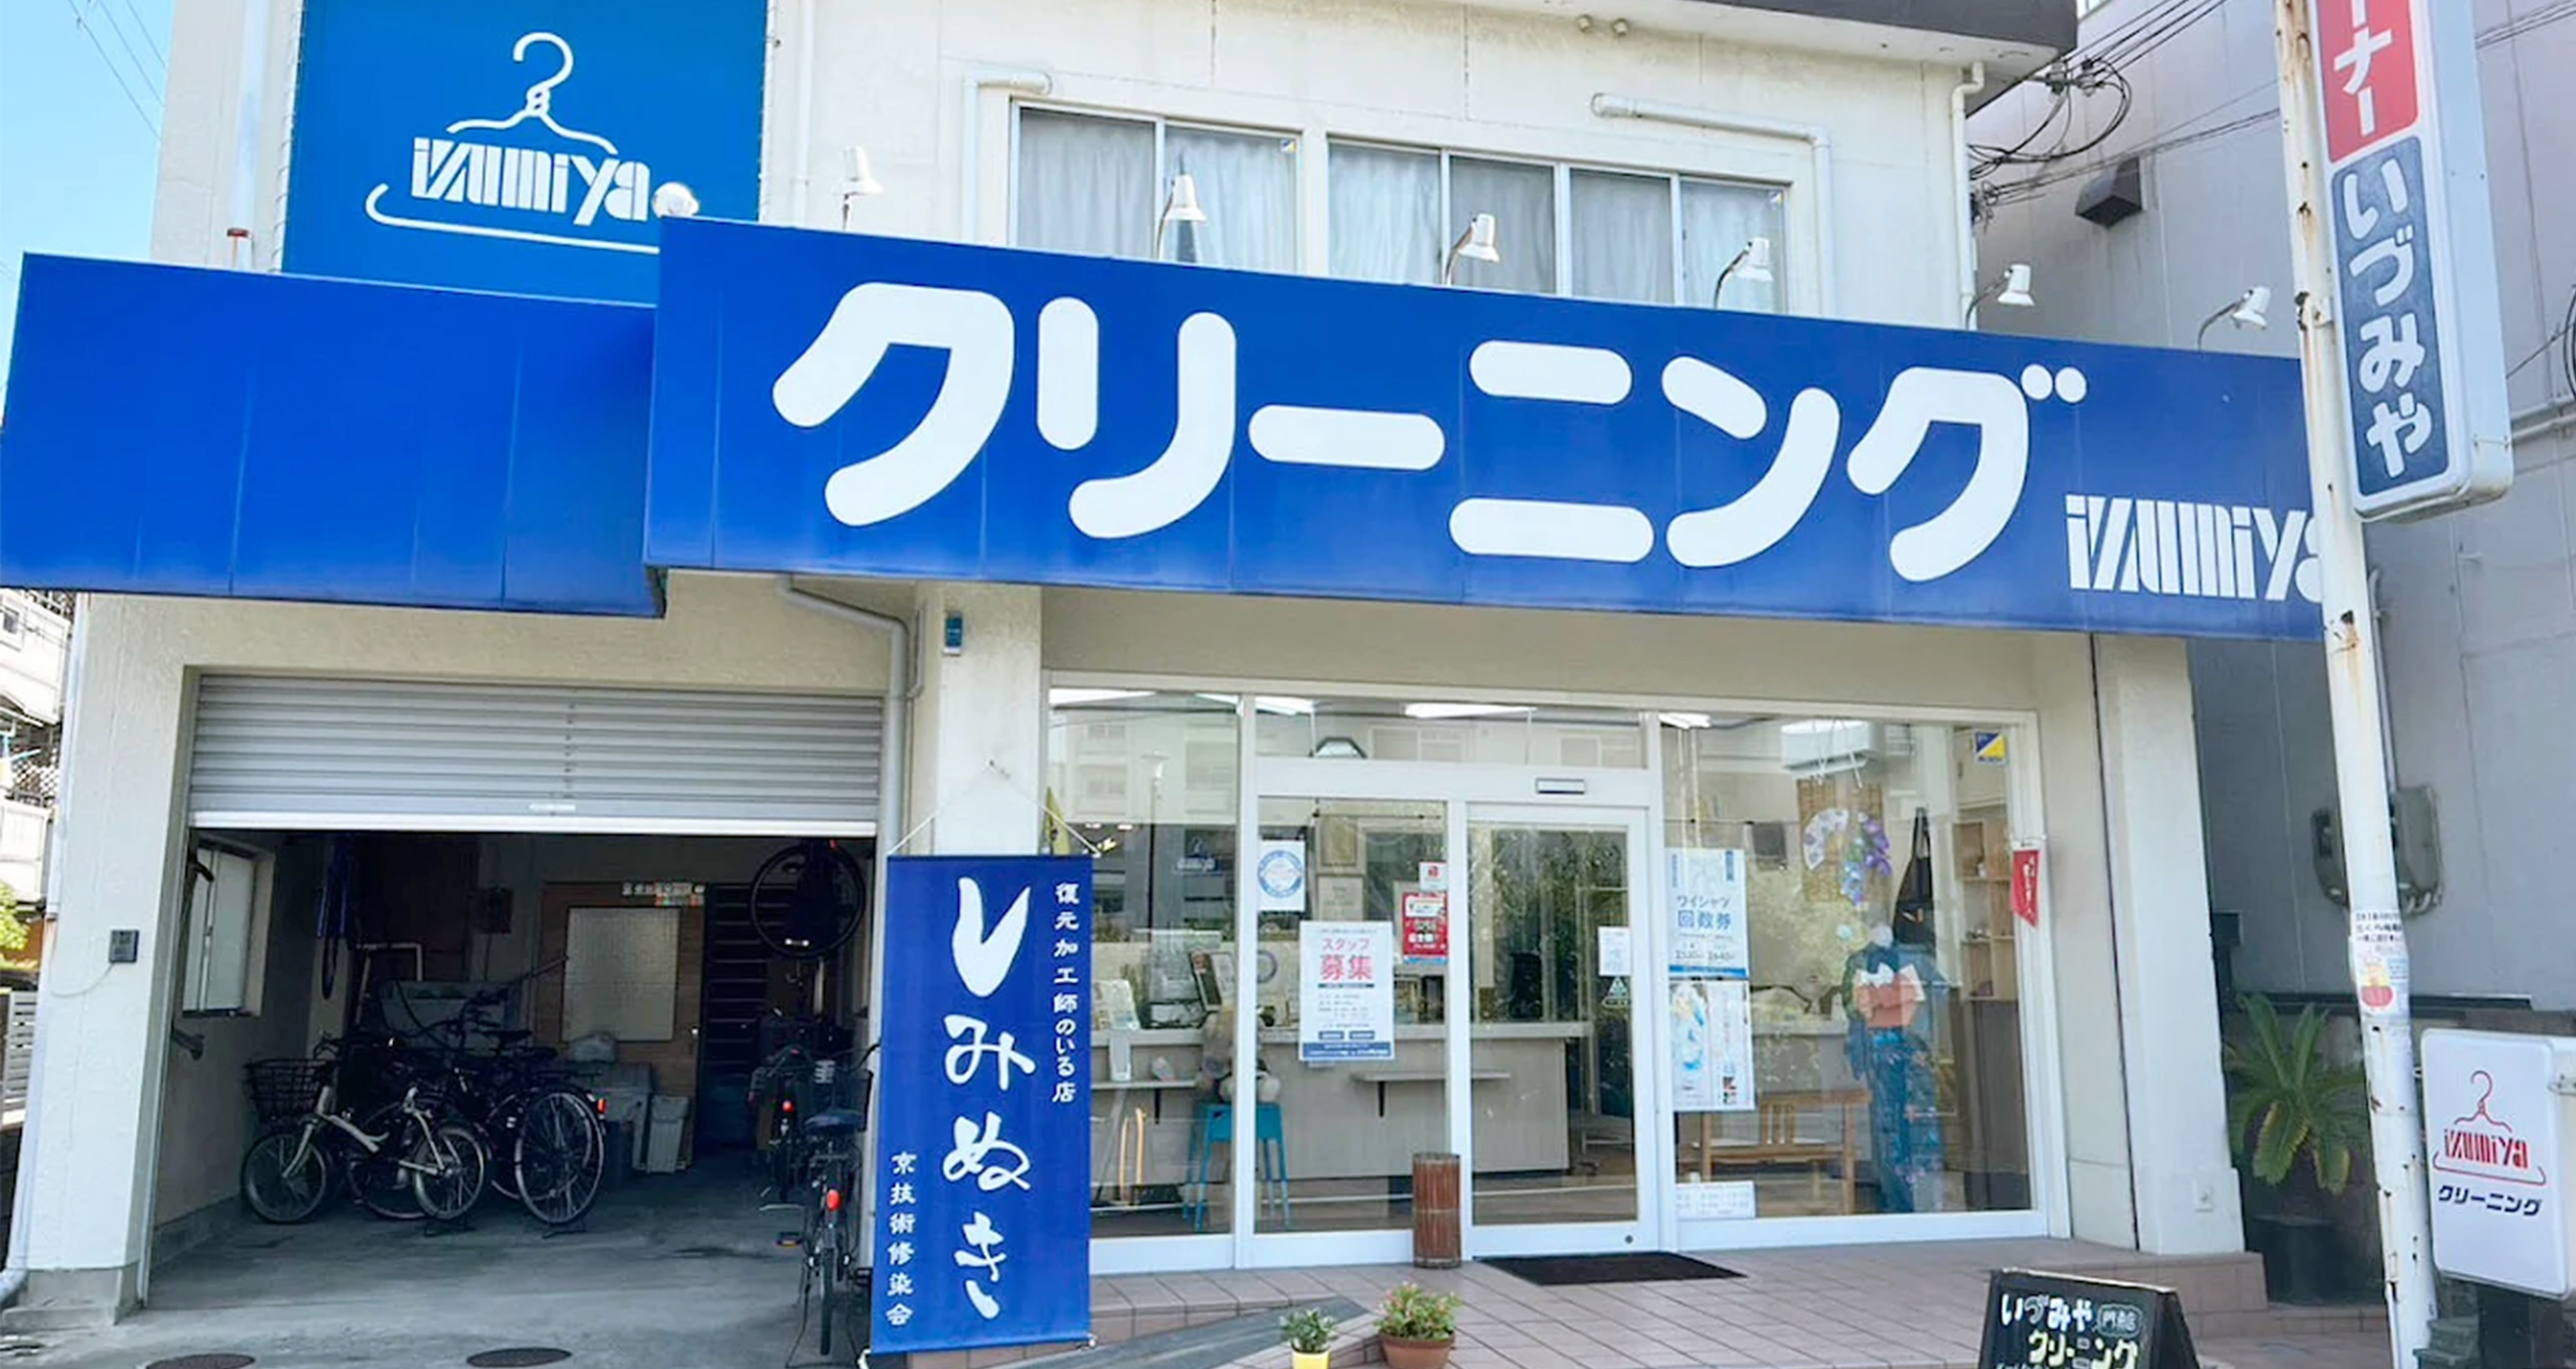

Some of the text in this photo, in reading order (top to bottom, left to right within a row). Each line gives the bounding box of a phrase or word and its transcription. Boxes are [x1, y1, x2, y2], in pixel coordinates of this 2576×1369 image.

[2342, 158, 2432, 478] いづみや
[772, 282, 2087, 581] クリーニング
[1676, 895, 1731, 908] ワイシャツ
[1678, 910, 1731, 930] 回数券
[1321, 938, 1370, 951] スタッフ
[1320, 954, 1372, 980] 募集
[1052, 882, 1079, 1103] 復元加工師のいる店
[942, 876, 1036, 1319] しみぬき
[2438, 1185, 2542, 1216] クリーニング
[886, 1151, 916, 1325] 京技術修染会
[2002, 1293, 2093, 1332] いづみや
[2029, 1330, 2138, 1369] クリーニング
